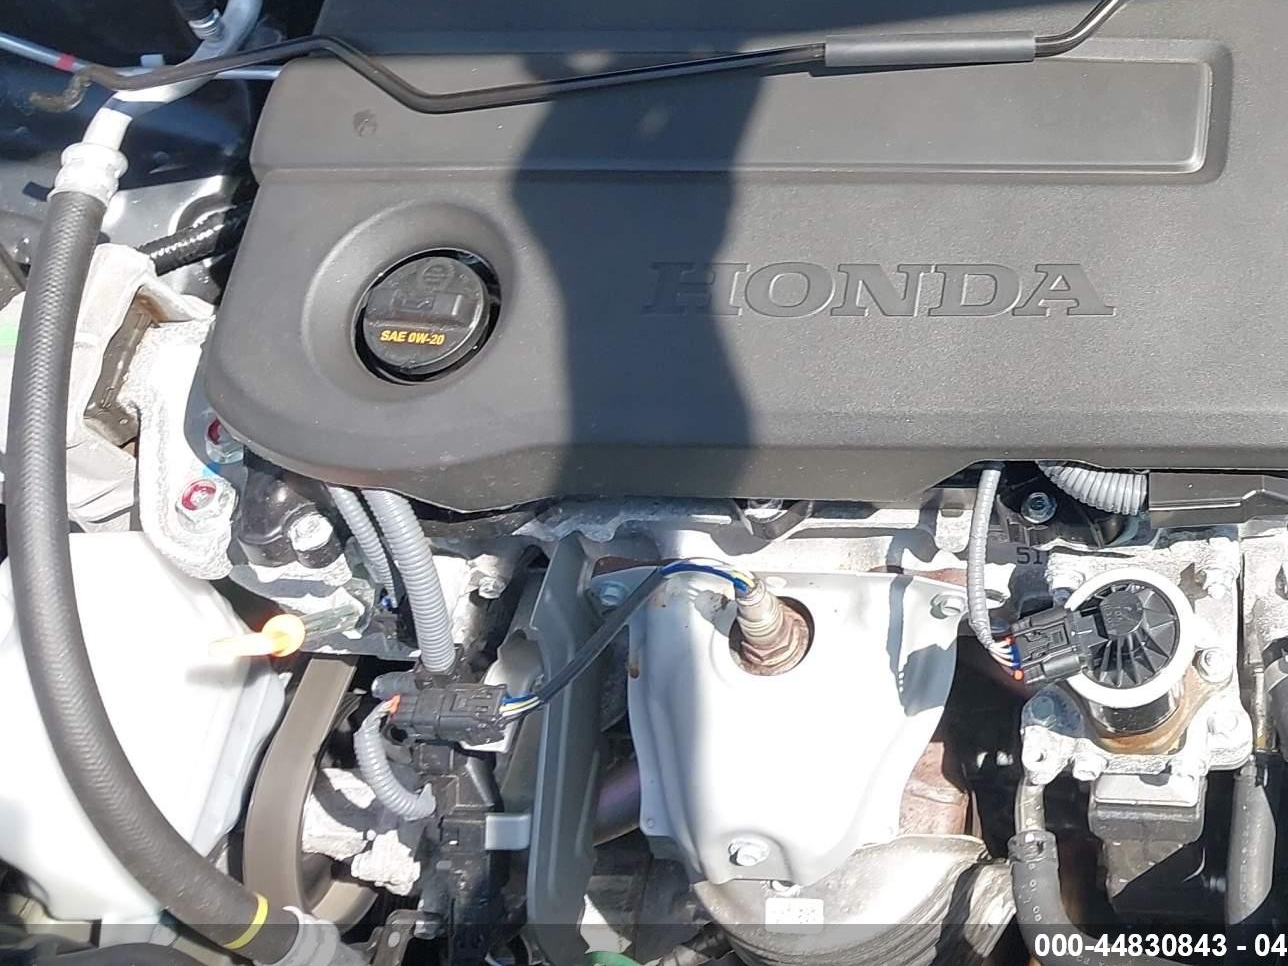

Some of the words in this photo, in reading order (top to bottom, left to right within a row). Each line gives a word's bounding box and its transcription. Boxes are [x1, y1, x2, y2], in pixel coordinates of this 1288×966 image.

[641, 261, 1117, 317] HONDA
[380, 329, 407, 342] SAE
[408, 332, 445, 345] 0W-20
